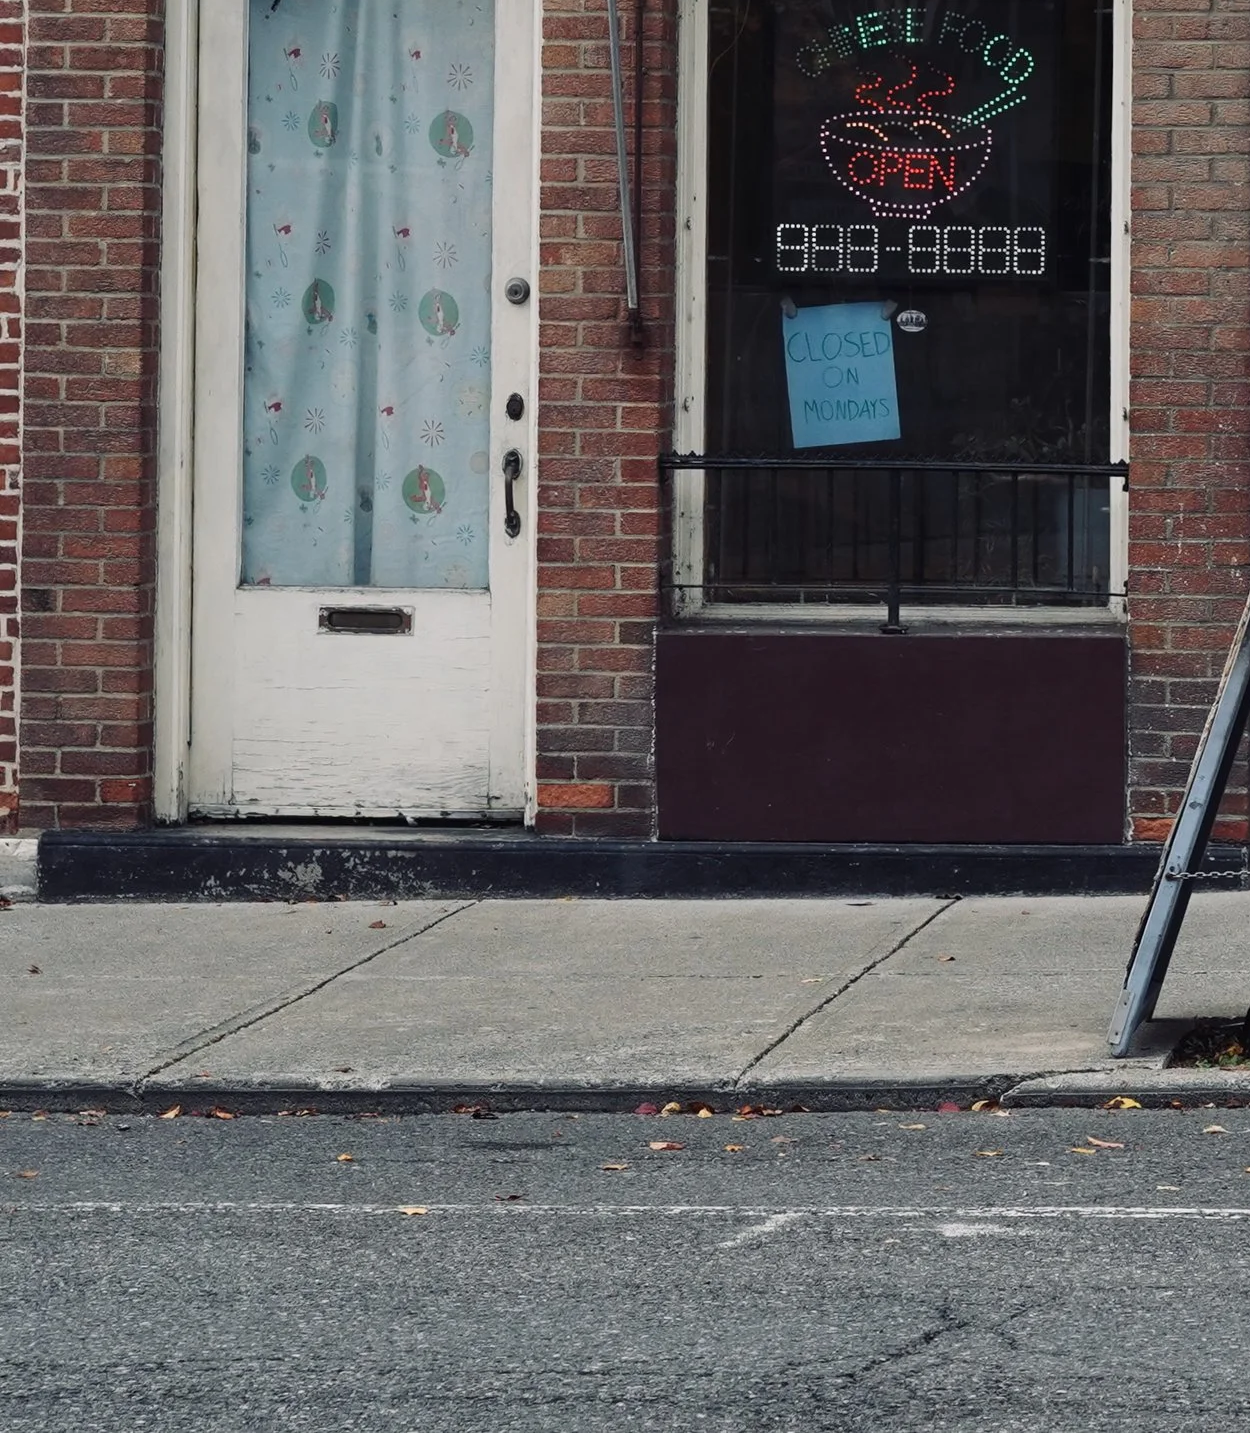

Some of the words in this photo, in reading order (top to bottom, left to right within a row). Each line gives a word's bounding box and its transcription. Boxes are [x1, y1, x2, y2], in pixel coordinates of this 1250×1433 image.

[848, 151, 957, 192] OPEN
[787, 330, 891, 364] CLOSED
[821, 366, 860, 388] ON
[803, 396, 891, 423] MONDAYS
